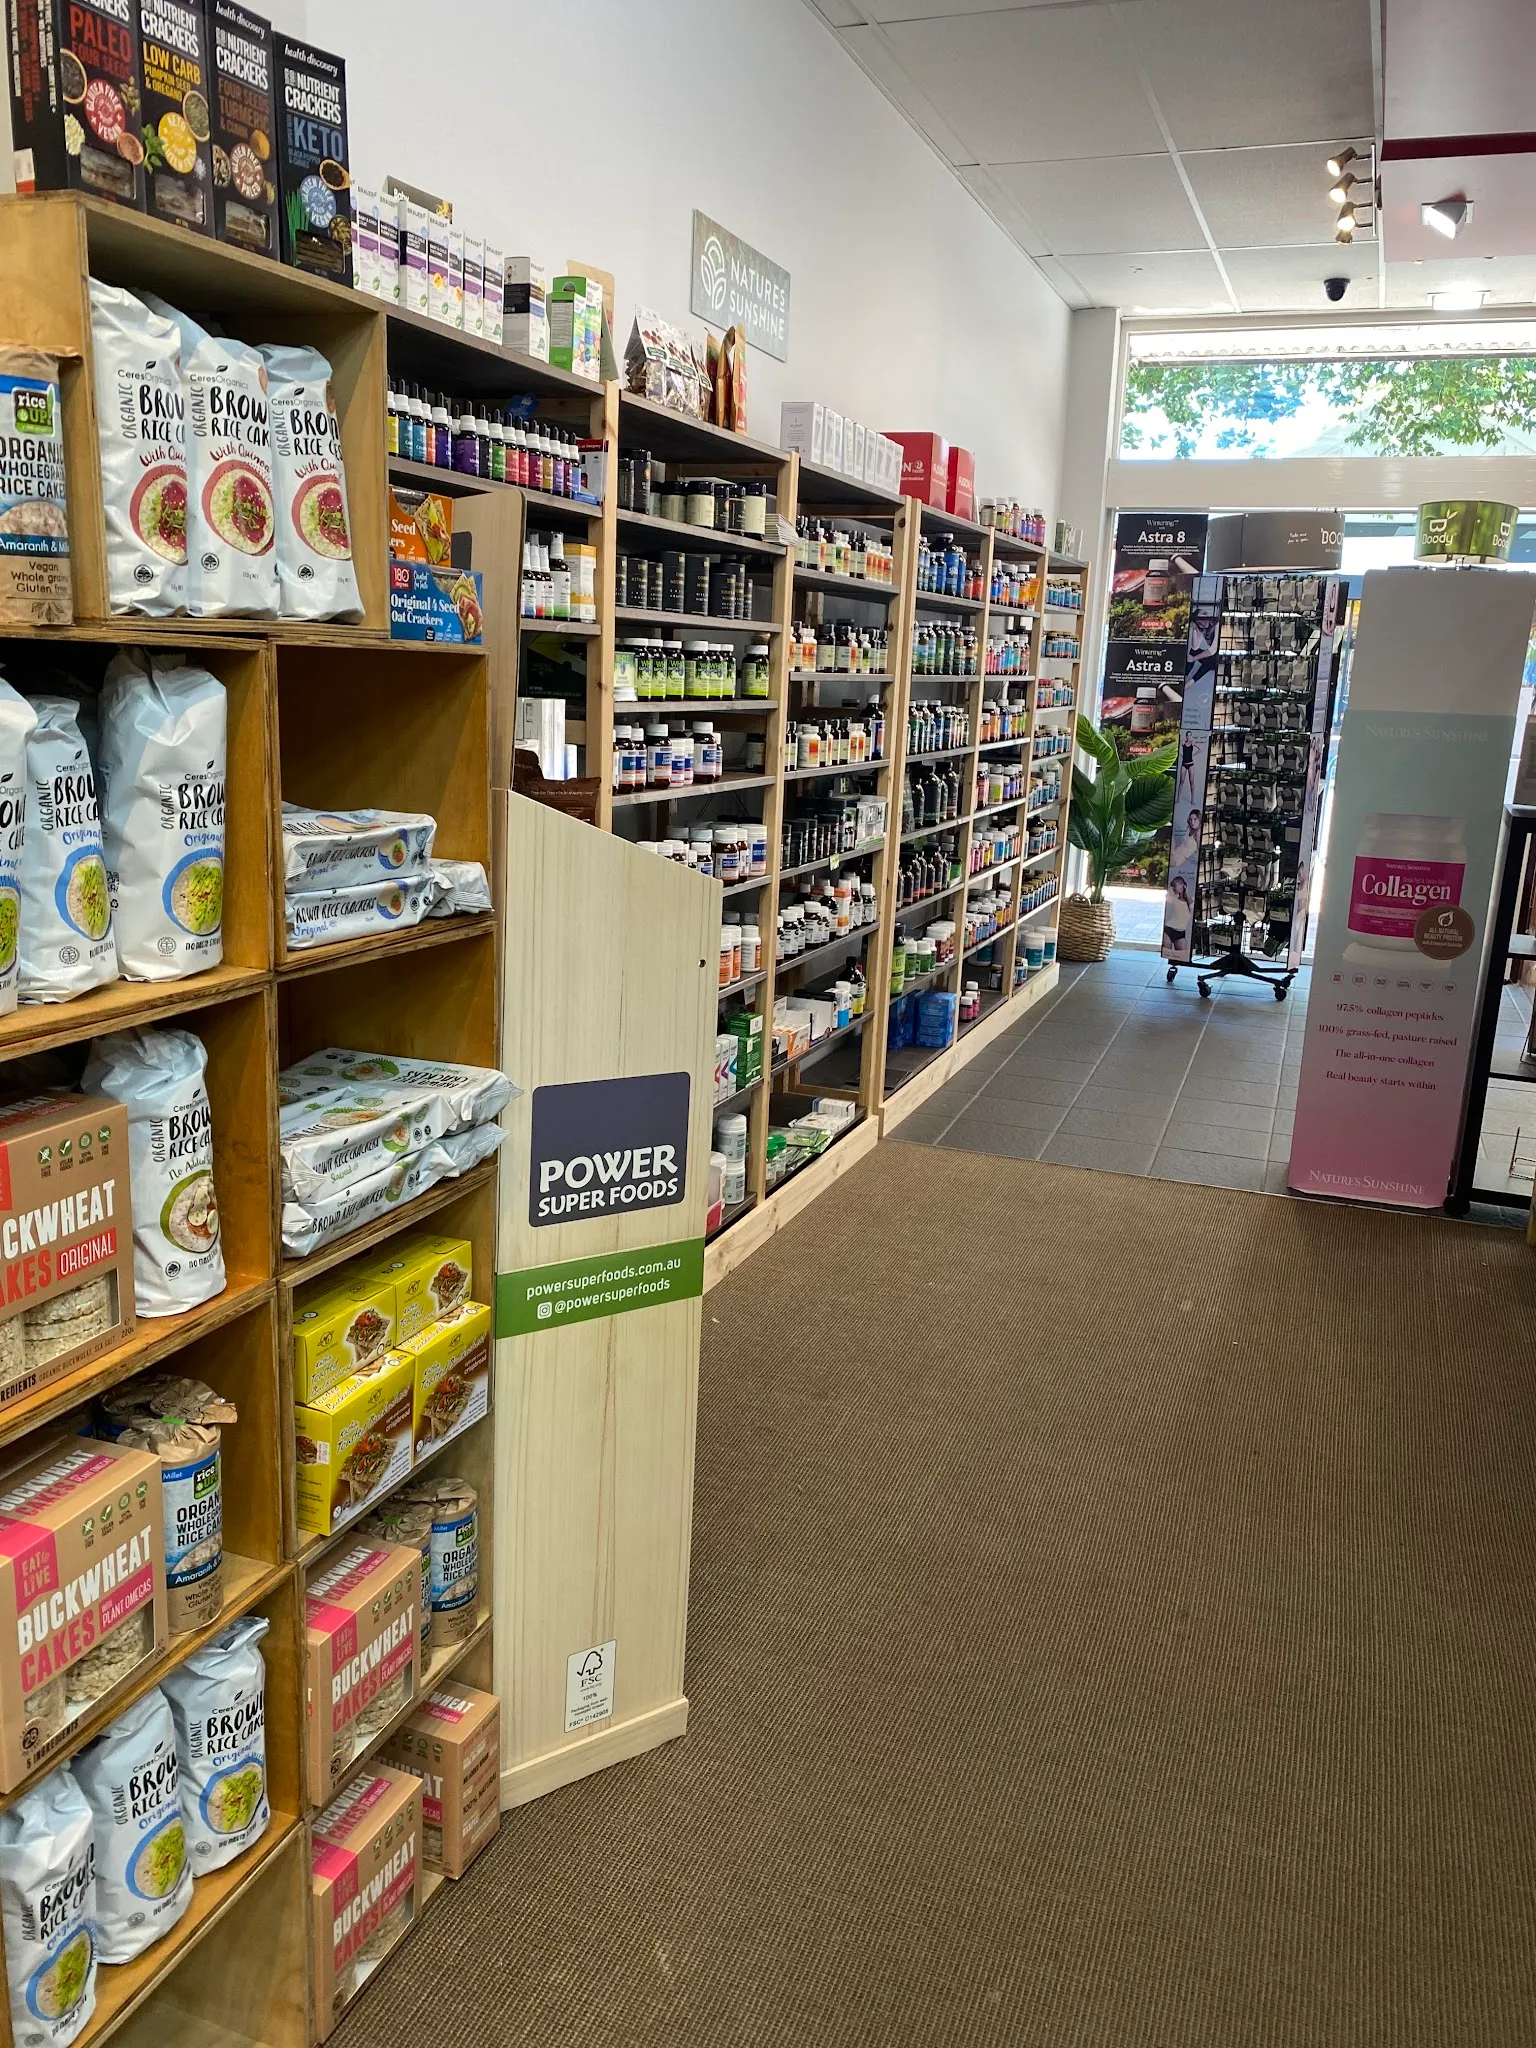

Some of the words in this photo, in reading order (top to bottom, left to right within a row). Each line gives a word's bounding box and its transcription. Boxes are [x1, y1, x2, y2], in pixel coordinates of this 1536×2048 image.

[153, 0, 197, 33] NUTRIENT
[215, 1, 237, 22] health
[236, 12, 265, 40] discovery
[69, 3, 131, 64] PALEO
[140, 9, 199, 58] CRACKERS
[227, 33, 267, 67] NUTRIENT
[284, 43, 306, 63] health
[306, 52, 338, 78] discovery
[142, 41, 169, 70] LOW
[172, 54, 201, 86] CARB
[144, 63, 175, 86] PUMPKIN
[216, 46, 269, 91] CRACKERS
[152, 78, 183, 102] OREGANO
[297, 71, 340, 103] NUTRIENT
[284, 85, 342, 125] CRACKERS
[294, 115, 344, 162] KETO
[357, 186, 377, 199] BRAUER
[429, 217, 447, 229] BRAUER
[730, 255, 785, 313] NATURES
[729, 289, 785, 341] SUNSHINE
[189, 374, 249, 390] CeresOrganics
[17, 392, 46, 408] rice
[118, 383, 137, 439] ORGANIC
[190, 386, 208, 438] ORGANIC
[271, 397, 324, 408] CeresOrganics
[141, 419, 172, 443] RICE
[211, 417, 242, 441] RICE
[274, 409, 291, 457] ORGANIC
[139, 445, 166, 467] With
[209, 441, 237, 461] With
[238, 443, 271, 472] Quinoa
[294, 437, 324, 456] RICE
[294, 458, 319, 480] With
[391, 518, 416, 536] Seed
[1137, 530, 1174, 544] Astra
[1176, 530, 1186, 544] 8
[1421, 532, 1454, 547] Boody
[0, 536, 49, 553] Amaranth
[50, 540, 58, 552] &
[11, 572, 45, 583] Whole
[29, 560, 60, 573] Vegan
[16, 583, 52, 595] Gluten
[55, 585, 68, 596] free
[390, 593, 431, 613] Original
[431, 600, 437, 612] 4
[438, 599, 461, 614] Seed
[391, 610, 406, 623] Oat
[406, 611, 444, 627] Crackers
[1126, 659, 1161, 672] Astra
[1163, 660, 1174, 673] 8
[35, 779, 54, 831] ORGANIC
[55, 804, 84, 829] RICE
[160, 784, 175, 830] ORGANIC
[179, 810, 208, 830] RICE
[184, 832, 223, 847] Original
[1361, 873, 1451, 906] Collagen
[321, 902, 340, 919] RICE
[340, 896, 377, 916] CRACKERS
[293, 921, 328, 939] Original
[1423, 932, 1442, 941] BEAUTY
[1442, 934, 1463, 943] PROTEIN
[1438, 928, 1460, 936] NATURAL
[1336, 1002, 1364, 1013] 97.5%
[1366, 1006, 1403, 1019] collagen
[1405, 1010, 1444, 1022] peptides
[1318, 1024, 1344, 1034] 100%
[1346, 1028, 1391, 1040] grass-fed,
[1392, 1033, 1427, 1045] pasture
[1429, 1035, 1458, 1047] raised
[1333, 1048, 1352, 1059] The
[1353, 1051, 1396, 1063] all-in-one
[1397, 1055, 1435, 1068] collagen
[1326, 1070, 1346, 1080] Real
[1347, 1072, 1378, 1086] beauty
[1380, 1077, 1405, 1087] starts
[1408, 1080, 1437, 1091] within
[149, 1118, 165, 1163] ORGANIC
[169, 1135, 199, 1160] RICE
[349, 1135, 381, 1160] CRACKERS
[539, 1144, 679, 1193] POWER
[538, 1188, 606, 1218] SUPER
[609, 1177, 679, 1206] FOODS
[1362, 1175, 1426, 1196] SUNSHINE
[312, 1210, 341, 1234] BROWN
[59, 1232, 114, 1276] ORIGINAL
[526, 1256, 682, 1300] powersuperfoods.com.au
[554, 1277, 671, 1315] @powersuperfoods
[94, 1343, 104, 1353] SEA
[104, 1336, 116, 1347] SALT
[411, 1324, 446, 1352] Buckwheat
[464, 1355, 487, 1375] crispbread
[421, 1367, 449, 1390] Toasted
[325, 1377, 364, 1411] Buckwheat
[385, 1408, 411, 1433] crispbread
[336, 1422, 368, 1455] Toasted
[0, 1449, 96, 1512] BUCKWHEAT
[163, 1472, 183, 1481] Millet
[196, 1467, 215, 1483] rice
[15, 1481, 77, 1517] CAKES
[177, 1530, 204, 1547] RICE
[457, 1522, 473, 1535] rice
[21, 1551, 42, 1579] EAT
[174, 1562, 213, 1585] Amaranth
[306, 1545, 373, 1598] BUCKWHEAT
[443, 1568, 463, 1582] RICE
[17, 1524, 152, 1655] BUCKWHEAT
[22, 1567, 52, 1599] LIVE
[184, 1585, 208, 1602] Whole
[324, 1572, 366, 1602] CAKES
[102, 1603, 124, 1629] PLANT
[124, 1578, 153, 1613] OMEGAS
[188, 1593, 213, 1609] Gluten
[440, 1597, 469, 1610] Amaranth
[20, 1610, 95, 1693] CAKES
[332, 1604, 415, 1706] BUCKWHEAT
[336, 1640, 353, 1663] LIVE
[580, 1673, 603, 1688] FSC
[332, 1668, 378, 1733] CAKES
[570, 1703, 590, 1714] Packaging
[583, 1692, 598, 1701] 100%
[26, 1757, 32, 1769] 5
[33, 1719, 79, 1764] INGREDIENTS
[189, 1720, 203, 1759] ORGANIC
[207, 1733, 239, 1756] RICE
[111, 1784, 129, 1825] ORGANIC
[131, 1789, 162, 1819] RICE
[311, 1770, 377, 1836] BUCKWHEAT
[463, 1796, 478, 1816] 100%
[478, 1772, 497, 1800] NATURAL
[328, 1803, 367, 1841] CAKES
[333, 1832, 416, 1946] BUCKWHEAT
[22, 1904, 35, 1941] ORGANIC
[40, 1904, 68, 1941] RICE
[334, 1907, 379, 1976] CAKES
